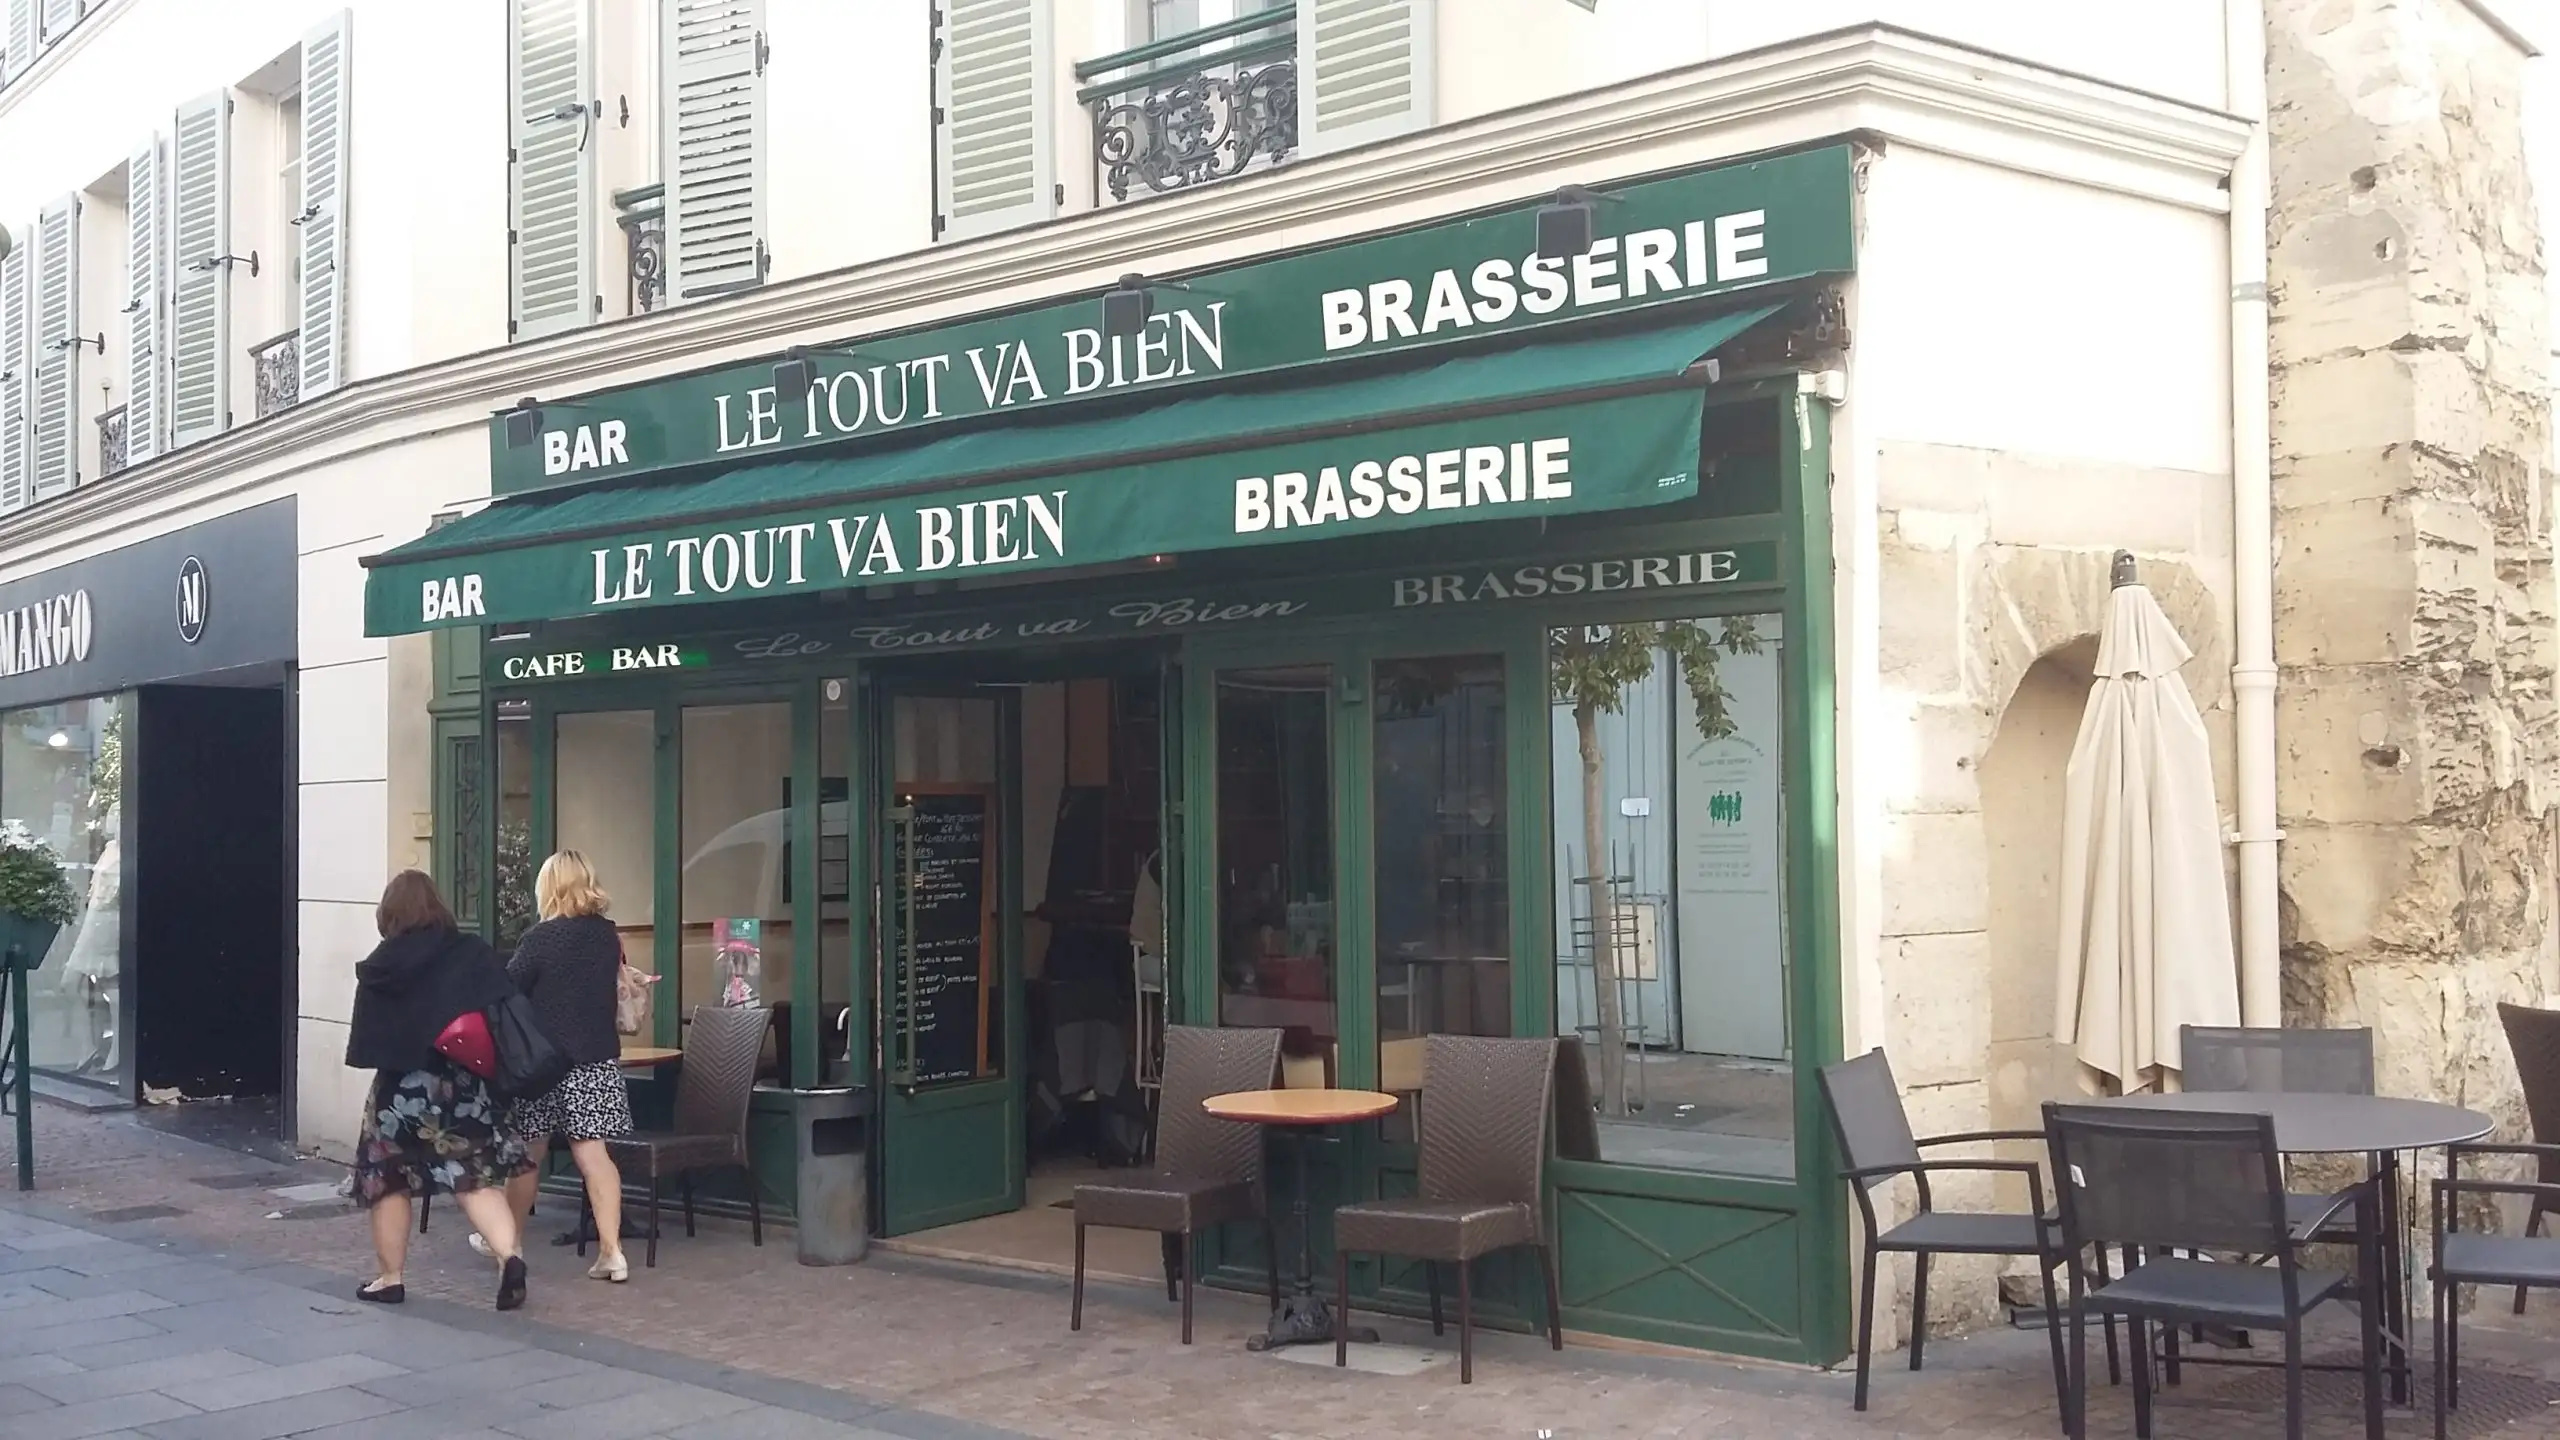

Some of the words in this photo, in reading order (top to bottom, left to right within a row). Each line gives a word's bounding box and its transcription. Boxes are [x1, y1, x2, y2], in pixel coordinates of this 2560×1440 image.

[1321, 209, 1768, 351] BRASSERIE
[714, 386, 783, 452] LE
[801, 354, 949, 438] TOUT
[966, 339, 1048, 409] VA
[1062, 302, 1227, 397] BIEN
[543, 419, 629, 476] BAR
[1234, 437, 1572, 533] BRASSERIE
[591, 543, 653, 605] LE
[666, 522, 816, 592] TOUT
[827, 512, 903, 579] VA
[915, 490, 1068, 572] BIEN
[182, 571, 200, 627] M
[422, 574, 486, 623] BAR
[1393, 550, 1740, 607] BRASSERIE
[0, 588, 92, 677] MANGO
[735, 632, 832, 658] Le
[850, 624, 1003, 650] Tout
[1017, 616, 1091, 636] va
[1108, 598, 1308, 628] Bien
[503, 652, 585, 680] CAFE
[611, 644, 681, 670] BAR
